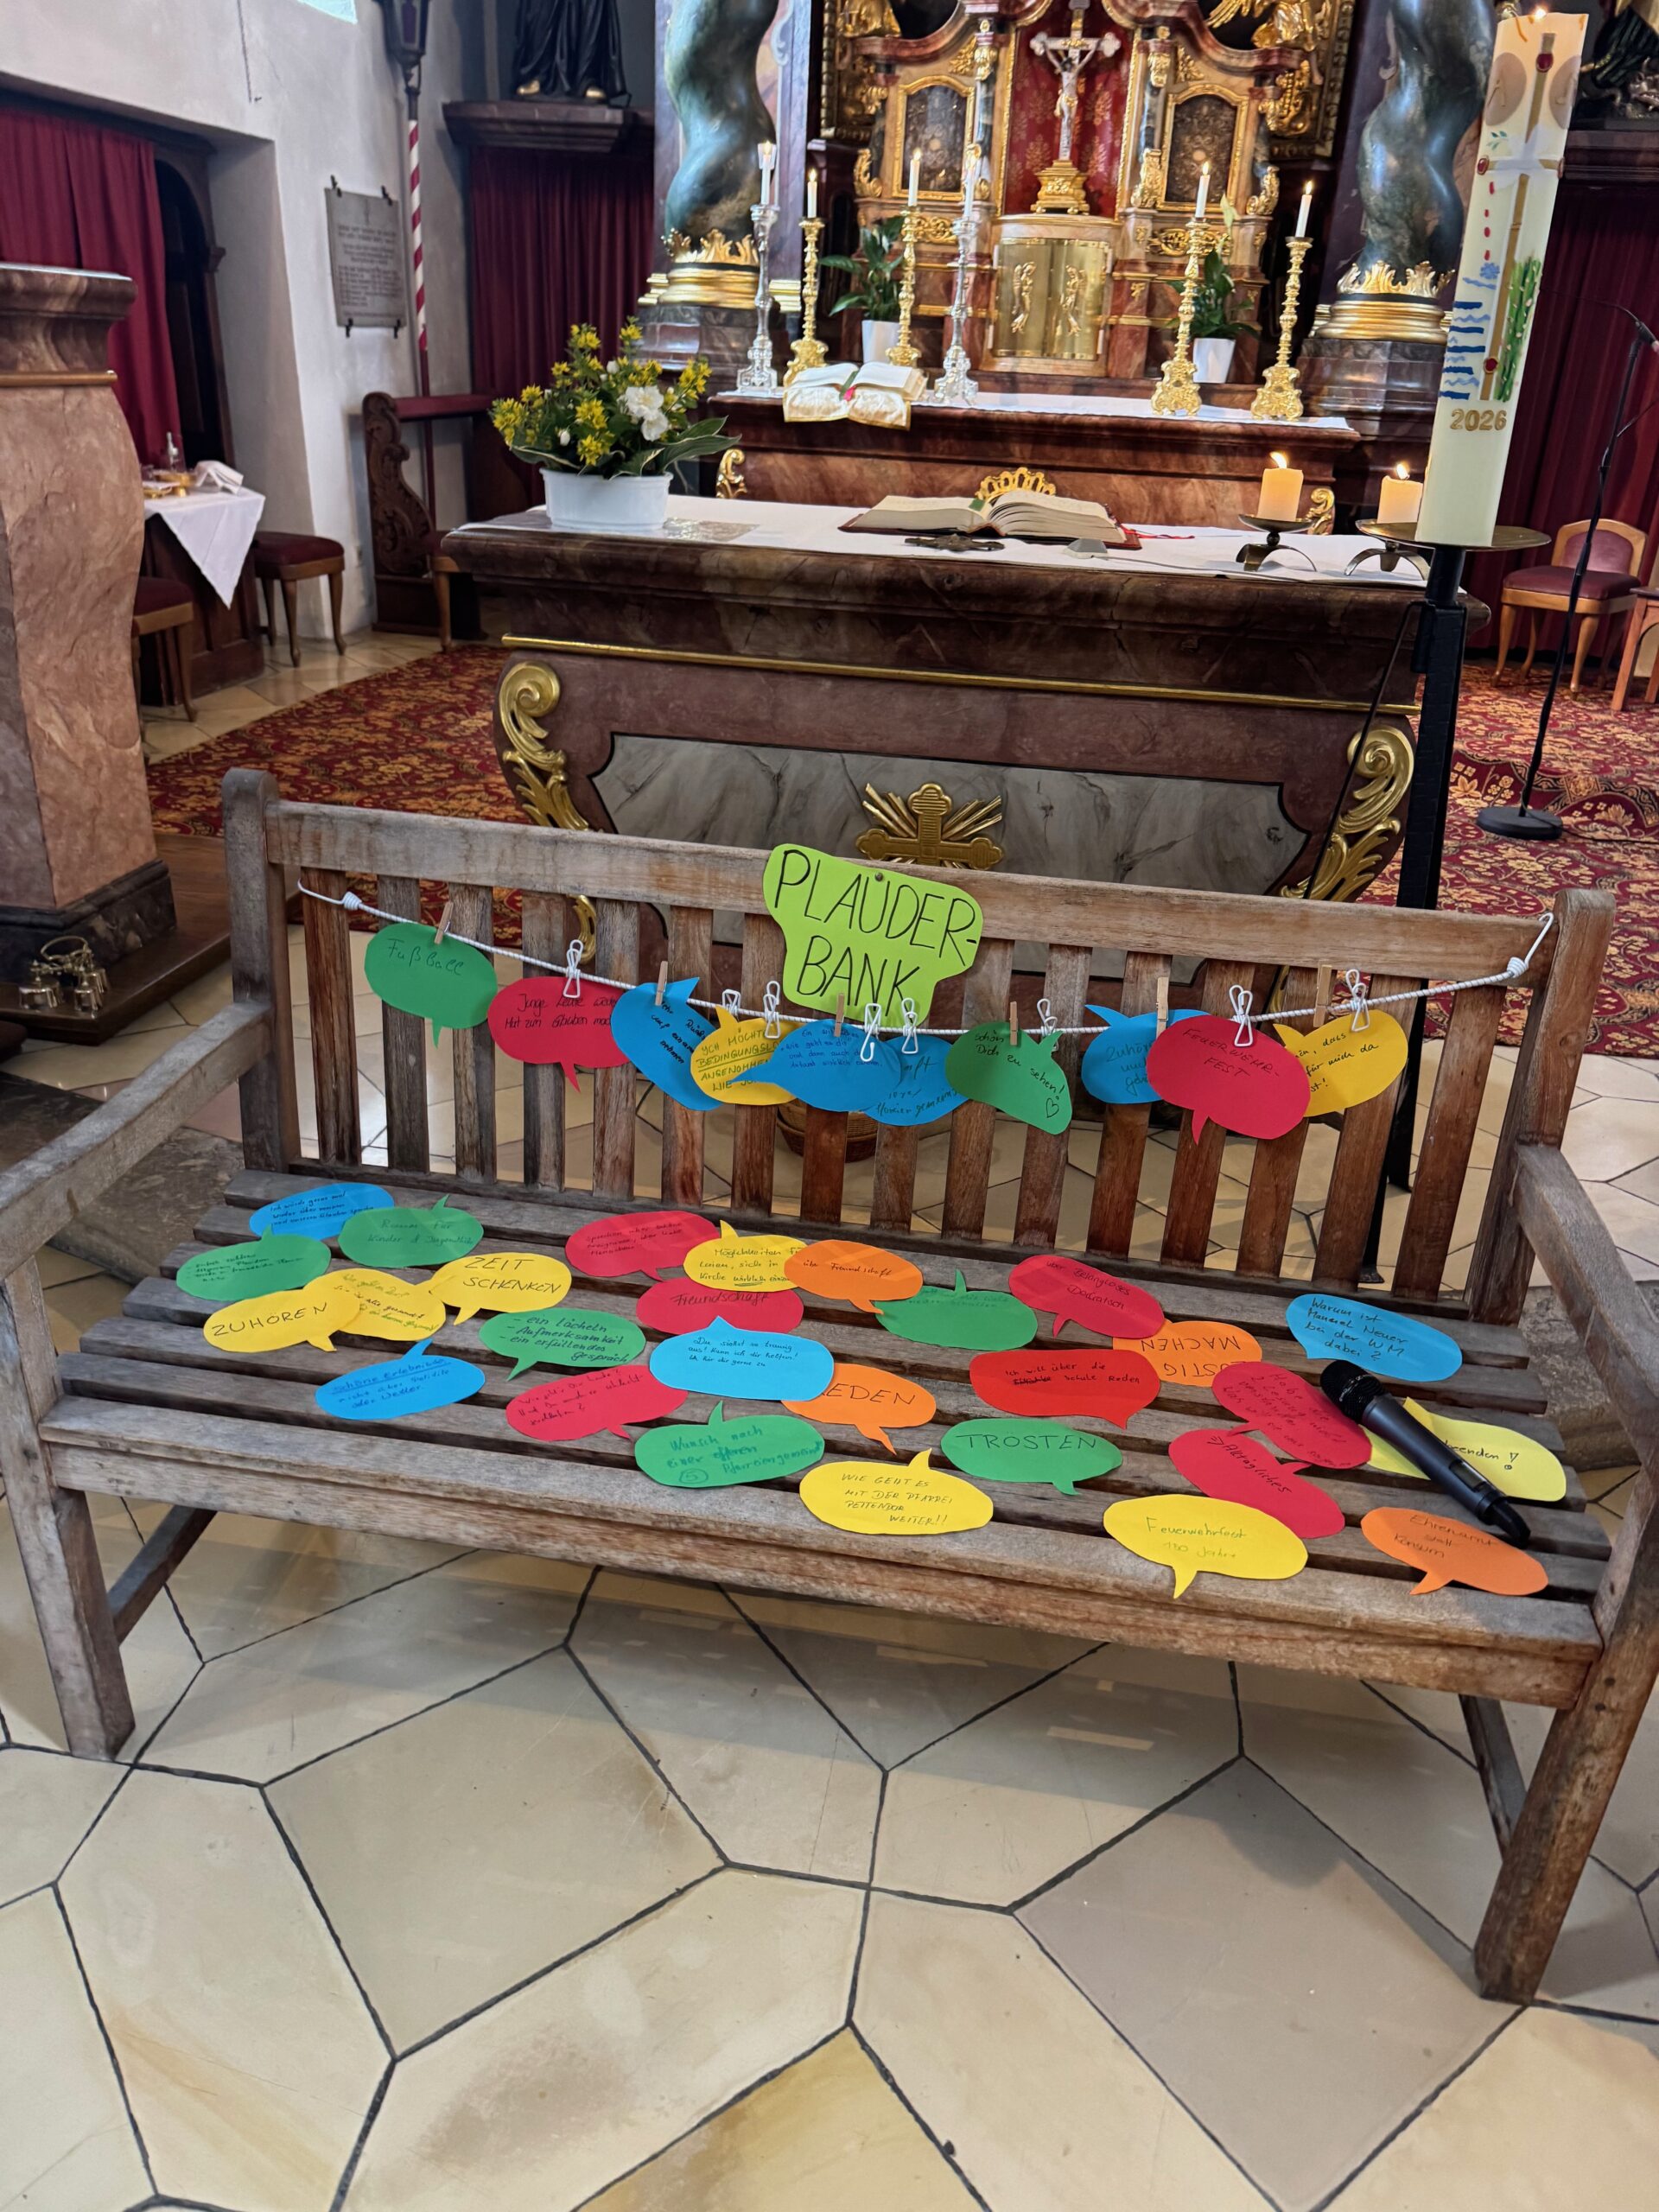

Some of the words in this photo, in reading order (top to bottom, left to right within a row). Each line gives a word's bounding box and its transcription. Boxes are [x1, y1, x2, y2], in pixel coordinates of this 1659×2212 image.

[1450, 408, 1507, 431] 2026
[774, 849, 977, 966] PLAUDER-
[387, 938, 465, 976] Fußball
[797, 935, 921, 1023] BANK
[1360, 1043, 1380, 1053] da
[1204, 1057, 1251, 1077] FEST
[464, 1257, 535, 1271] ZEIT
[462, 1277, 562, 1294] SCHENKEN
[1312, 1297, 1352, 1316] Warum
[1360, 1313, 1382, 1324] ist
[1305, 1321, 1325, 1334] bei
[1333, 1329, 1360, 1341] der
[1363, 1325, 1409, 1344] Neuer
[1141, 1336, 1242, 1352] MACHEN
[1324, 1338, 1361, 1357] dabei
[841, 1472, 868, 1482] WIE
[871, 1490, 899, 1500] DER
